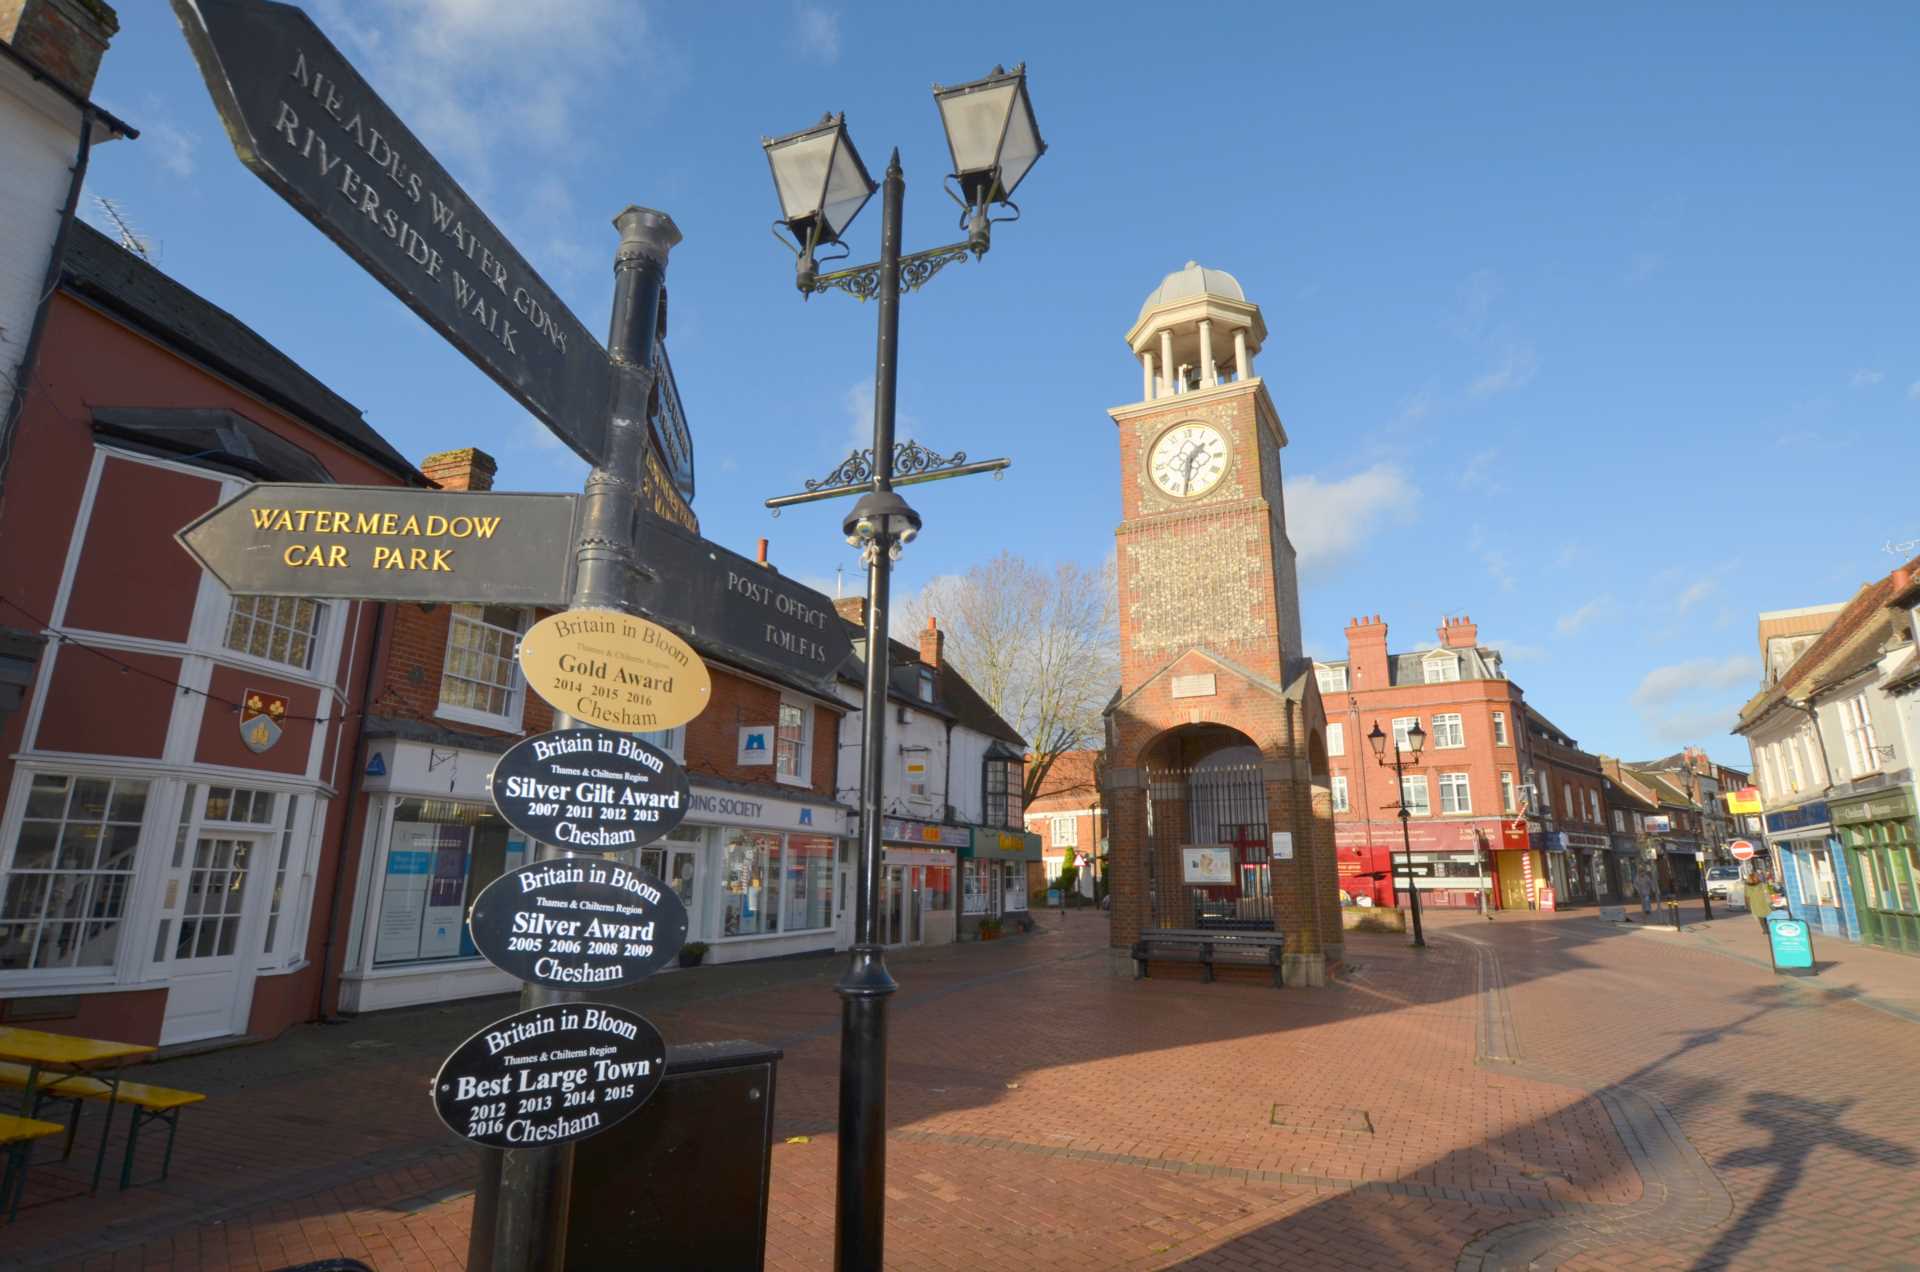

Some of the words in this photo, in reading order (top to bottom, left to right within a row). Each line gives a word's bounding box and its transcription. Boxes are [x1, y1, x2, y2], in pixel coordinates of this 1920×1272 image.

[289, 48, 422, 202] MEADES
[430, 192, 508, 296] WATER
[514, 287, 567, 354] GDNS
[275, 100, 444, 282] RIVERSIDE
[453, 270, 518, 355] WALK
[251, 508, 501, 539] WATERMEADOW
[284, 544, 349, 567] CAR
[372, 546, 454, 571] PARK
[728, 571, 774, 605] POST
[776, 594, 827, 629] OFFICE
[555, 616, 615, 638] Britain
[623, 619, 637, 637] in
[642, 627, 689, 667] Bloom
[764, 624, 825, 661] TOILETS
[559, 654, 607, 679] Gold
[613, 667, 673, 693] Award
[554, 678, 582, 693] 2014
[592, 685, 618, 700] 2015
[627, 692, 652, 706] 2016
[577, 696, 656, 726] Chesham
[532, 733, 592, 761] Britain
[598, 734, 613, 753] in
[617, 738, 664, 774] Bloom
[551, 765, 580, 776] Thames
[582, 768, 589, 776] &
[624, 772, 648, 783] Region
[506, 776, 570, 801] Silver
[576, 783, 615, 804] Gilt
[620, 787, 680, 809] Award
[528, 803, 559, 816] 2007
[565, 805, 593, 818] 2011
[600, 807, 627, 820] 2012
[633, 809, 659, 822] 2013
[718, 798, 763, 818] SOCIETY
[555, 822, 636, 845] Chesham
[519, 863, 583, 893] Britain
[589, 864, 605, 884] in
[611, 868, 661, 905] Bloom
[536, 897, 568, 908] Thames
[569, 900, 577, 909] &
[580, 900, 614, 912] Chilterns
[616, 904, 642, 915] Region
[512, 912, 580, 937] Silver
[584, 918, 655, 941] Award
[508, 937, 542, 951] 2005
[549, 940, 581, 954] 2006
[587, 942, 618, 956] 2008
[624, 944, 653, 957] 2009
[535, 957, 623, 983] Chesham
[486, 1014, 554, 1054] Britain
[561, 1010, 578, 1030] in
[583, 1009, 637, 1040] Bloom
[504, 1053, 537, 1065] Thames
[539, 1053, 548, 1062] &
[550, 1048, 587, 1060] Chilterns
[589, 1045, 617, 1058] Region
[455, 1074, 512, 1101] Best
[517, 1067, 587, 1092] Large
[594, 1060, 650, 1082] Town
[470, 1103, 506, 1121] 2012
[518, 1096, 552, 1114] 2013
[563, 1089, 595, 1107] 2014
[605, 1085, 634, 1101] 2015
[468, 1120, 503, 1137] 2016
[506, 1112, 600, 1142] Chesham
